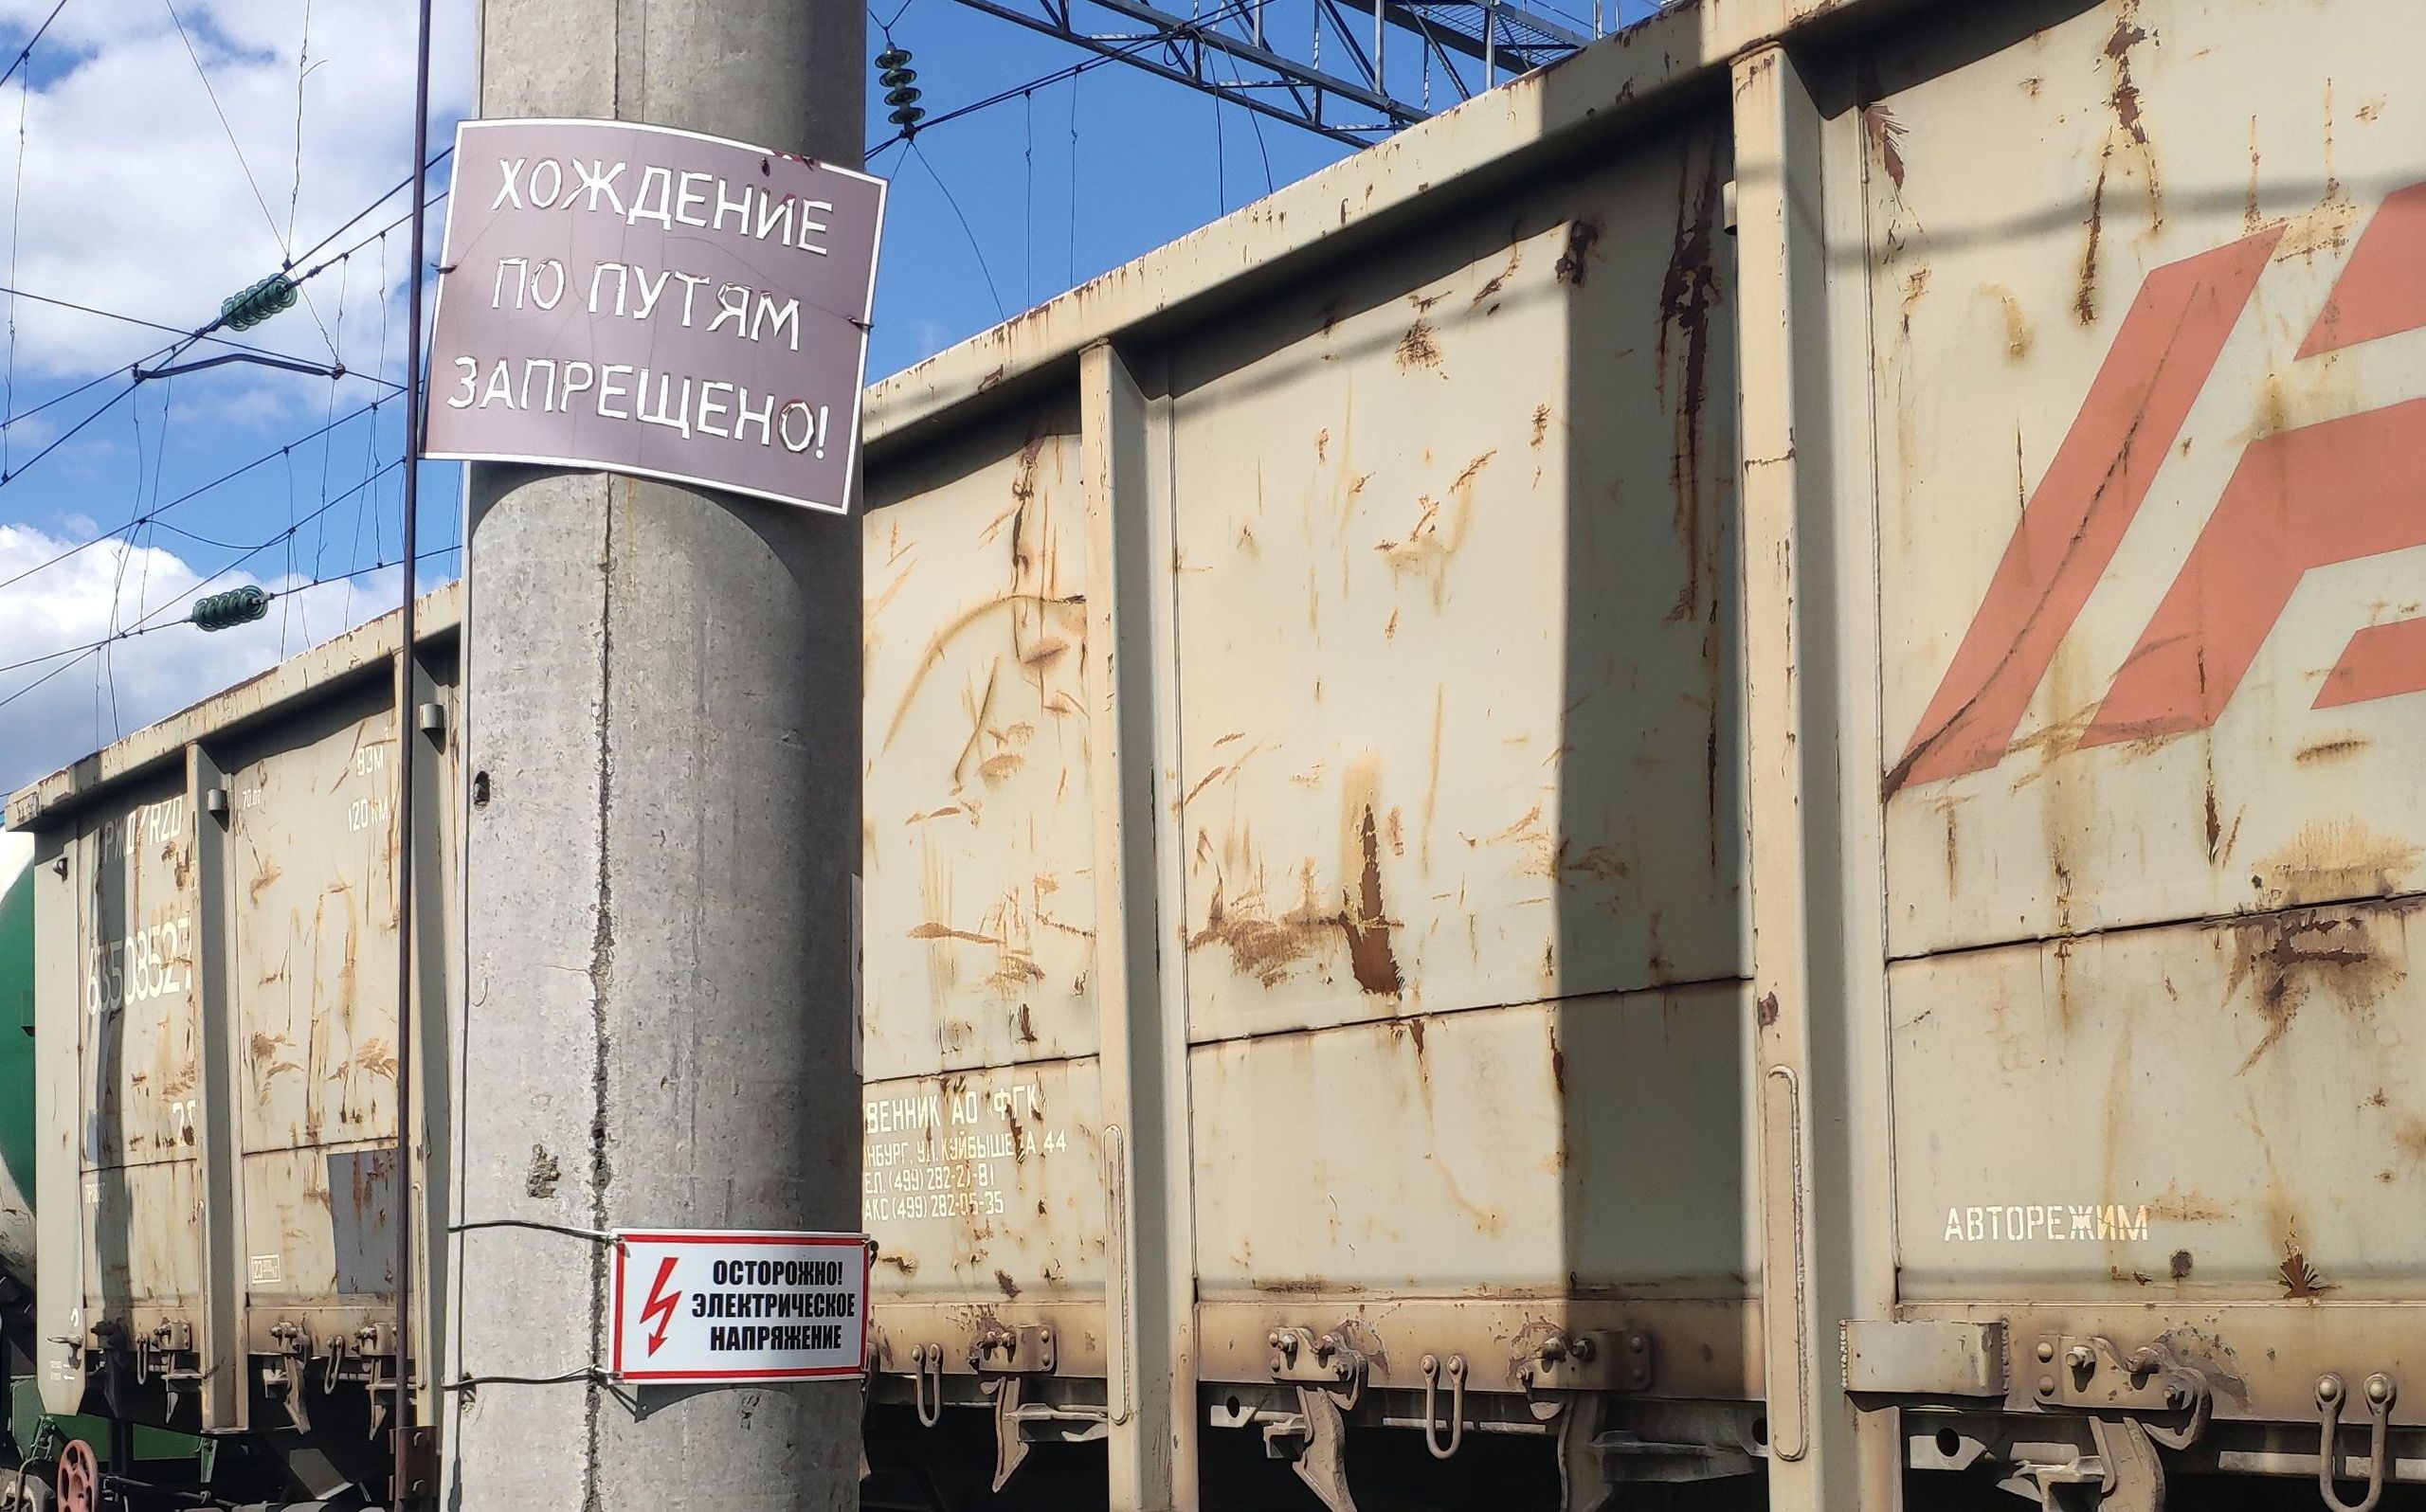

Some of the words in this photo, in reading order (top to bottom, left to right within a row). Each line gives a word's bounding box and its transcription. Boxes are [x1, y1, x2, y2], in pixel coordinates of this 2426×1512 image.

[491, 157, 833, 255] ХОЖДЕНИЕ
[491, 257, 566, 311] ПО
[588, 260, 800, 351] ПУТЯМ
[446, 354, 830, 459] ЗАПРЕЩЕНО!
[866, 1094, 941, 1134] ВЕННИК
[950, 1090, 978, 1126] АО
[941, 1130, 1037, 1161] КУЙБЫШЕА
[1043, 1128, 1067, 1154] 44
[889, 1168, 924, 1193] (499)
[864, 1197, 889, 1221] АКС
[892, 1196, 927, 1219] (499)
[1944, 1204, 2149, 1242] АВТОРЕЖИМ
[713, 1260, 842, 1286] ОСТОРОЖНО!
[692, 1293, 856, 1318] ЭЛЕКТРИЧЕСКОЕ
[711, 1325, 842, 1351] НАПРЯЖЕНИЕ
